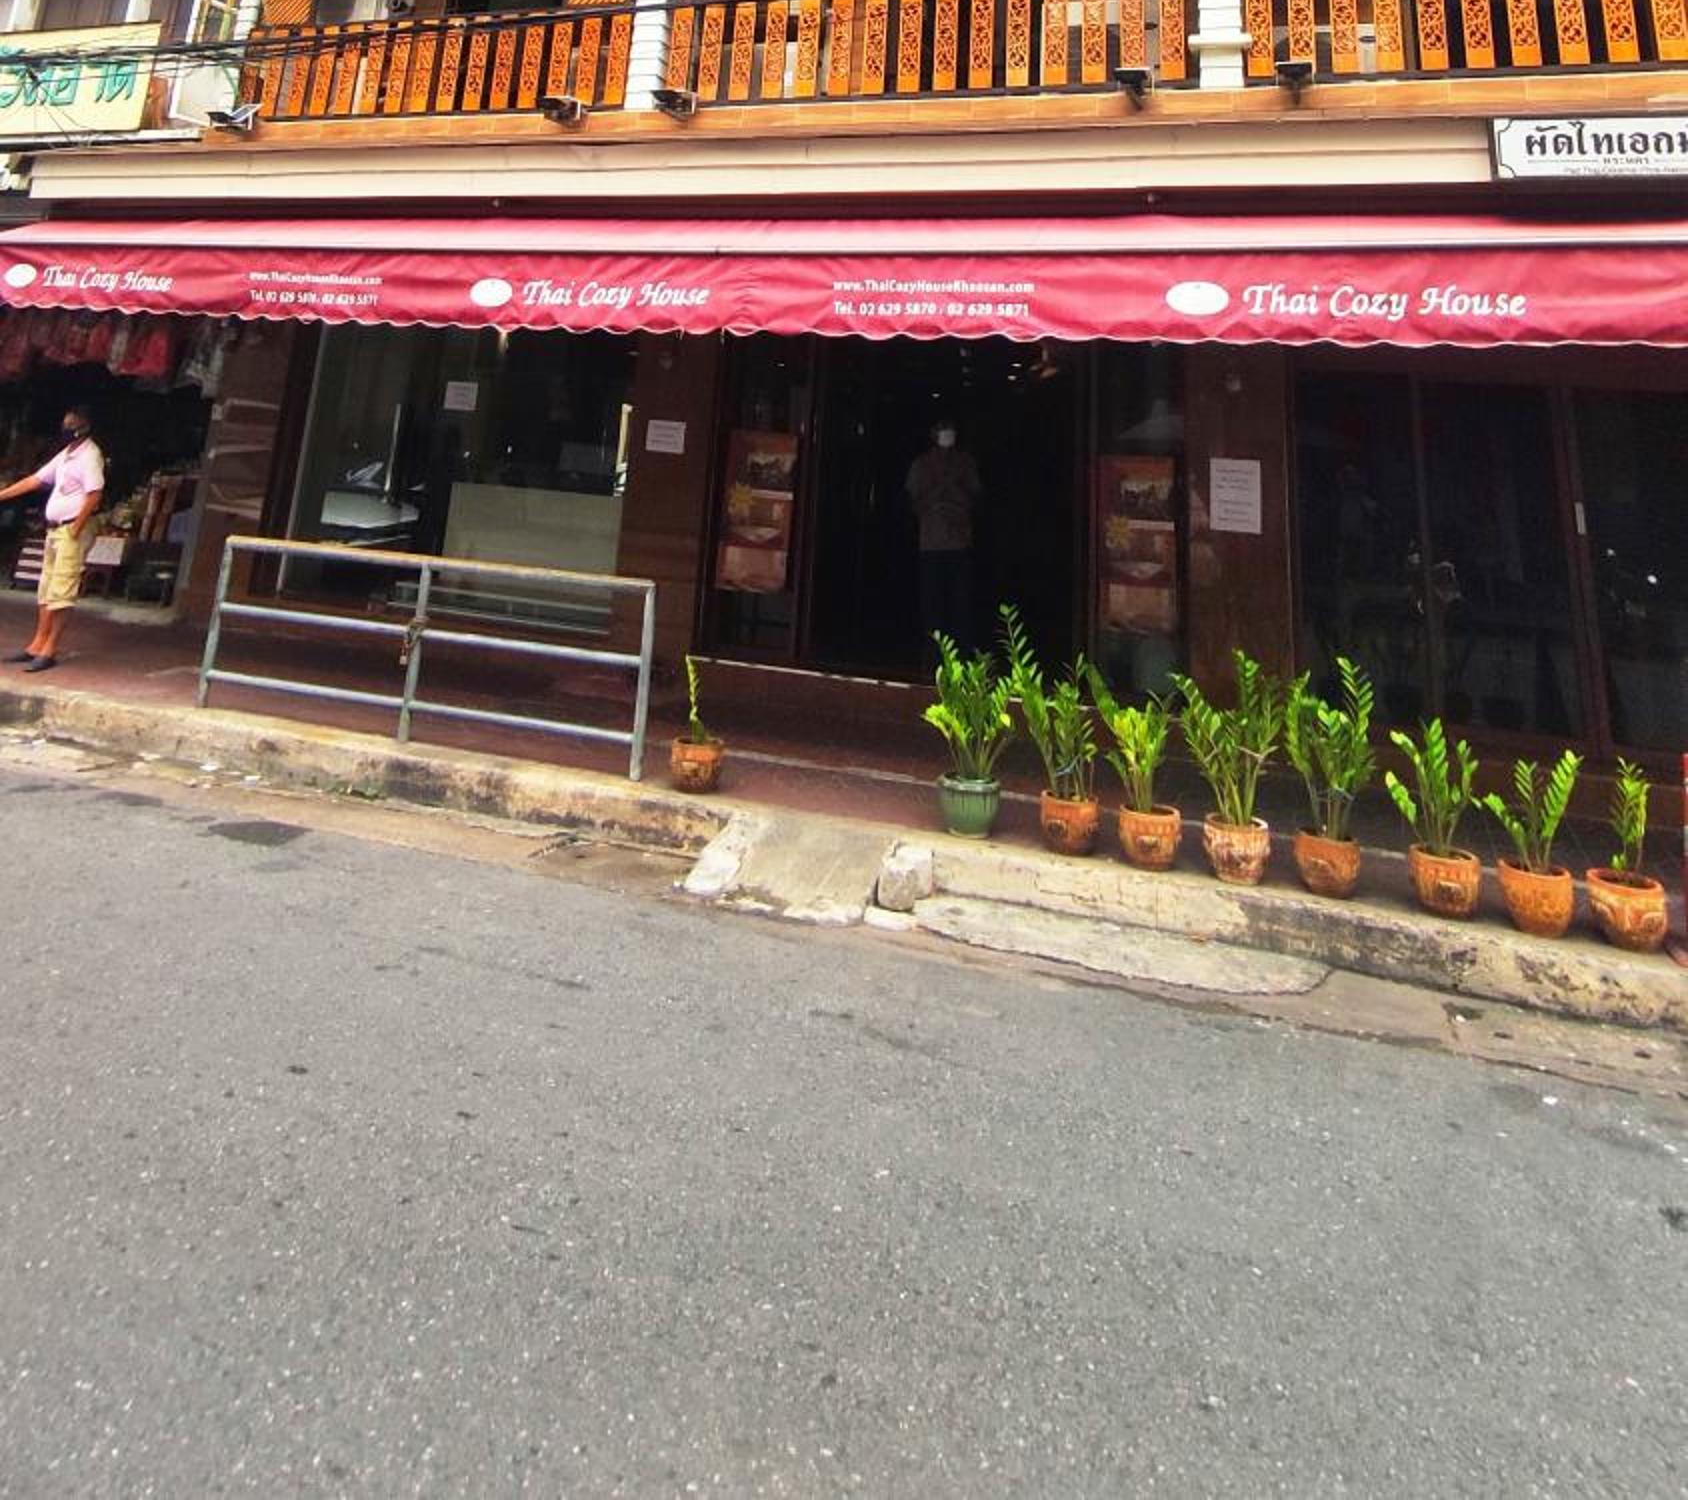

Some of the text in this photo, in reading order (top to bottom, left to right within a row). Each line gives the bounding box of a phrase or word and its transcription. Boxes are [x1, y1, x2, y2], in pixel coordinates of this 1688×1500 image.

[43, 266, 174, 293] Thai Cozy House
[523, 278, 710, 309] Thai Cozy House
[859, 303, 875, 316] 02
[877, 303, 901, 316] 629
[903, 303, 936, 316] 5870
[947, 303, 964, 315] 02
[967, 304, 993, 316] 629
[997, 304, 1029, 317] 5871
[1242, 283, 1527, 321] Thai Cozy House
